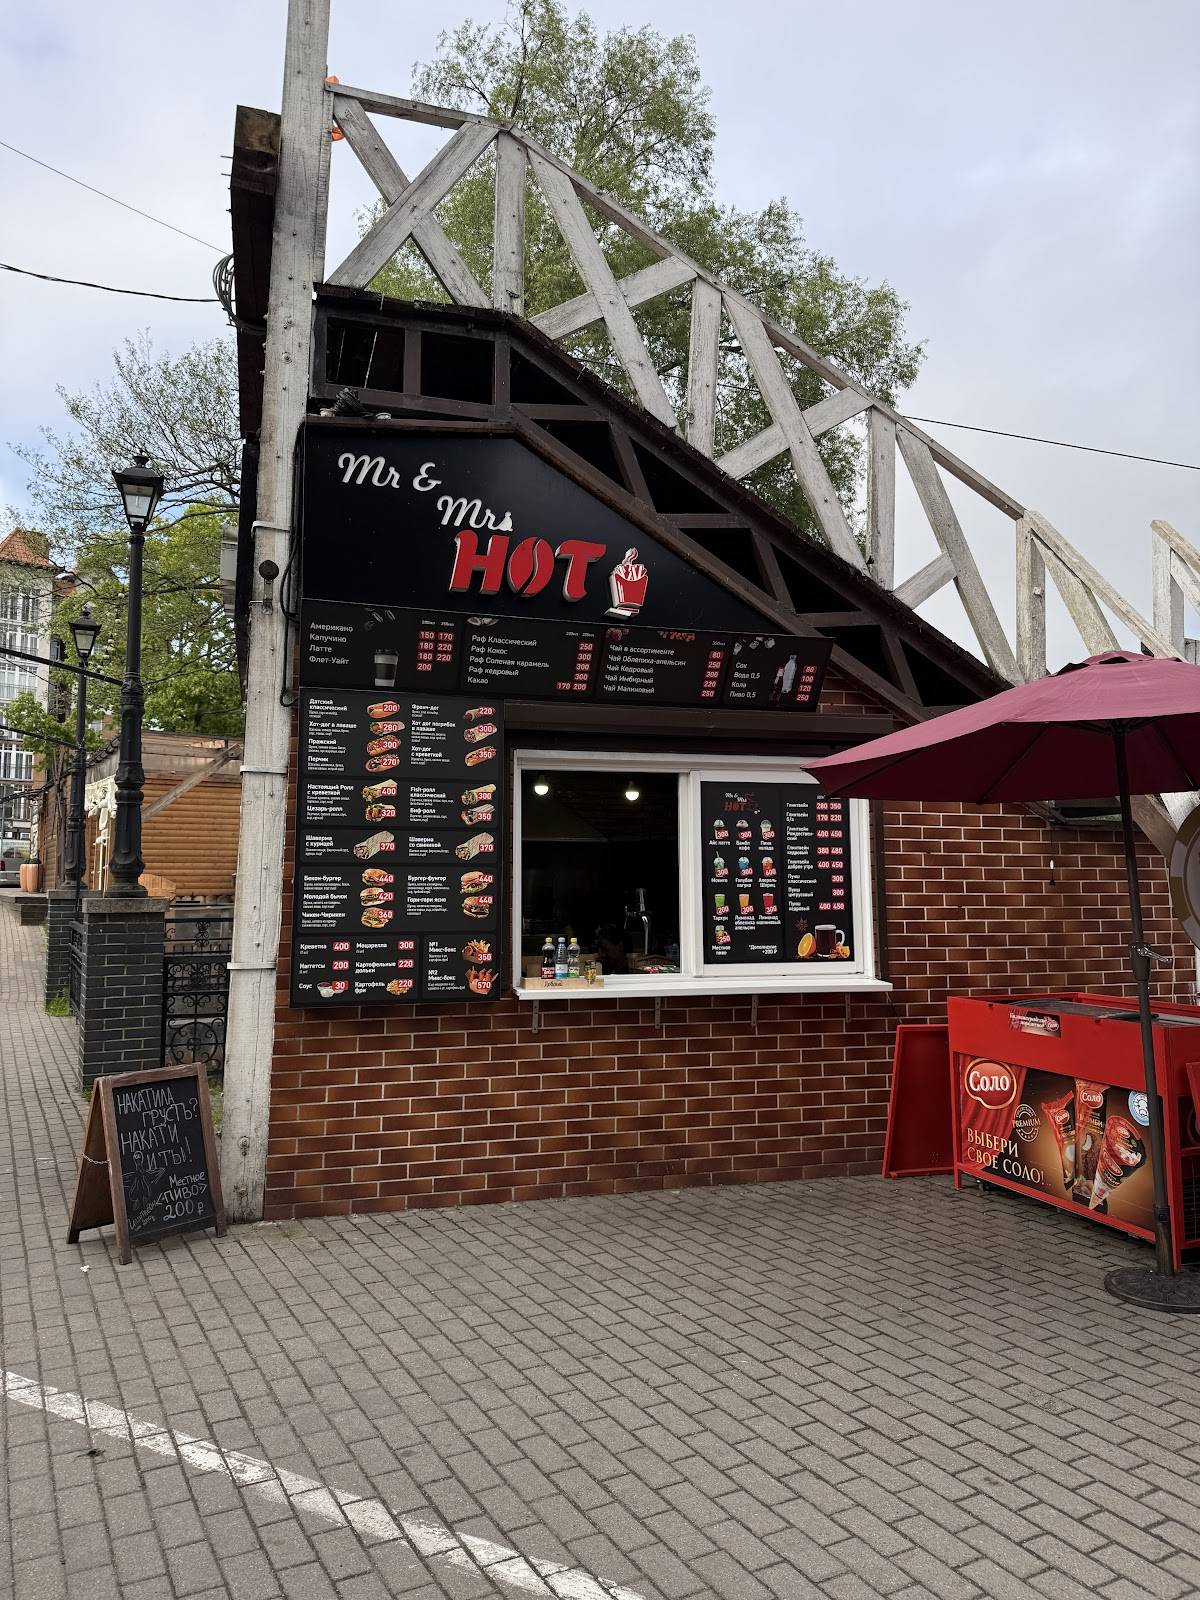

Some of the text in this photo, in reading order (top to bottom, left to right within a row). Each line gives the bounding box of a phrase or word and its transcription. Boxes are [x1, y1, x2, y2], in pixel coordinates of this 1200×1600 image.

[337, 452, 442, 491] Mr &
[436, 495, 513, 532] Mrs
[450, 529, 606, 602] HOT
[310, 622, 354, 632] Американо
[309, 633, 347, 643] Капучино
[420, 631, 453, 640] 150 170
[471, 635, 537, 647] Раф Классический
[309, 644, 332, 653] Латте
[419, 642, 452, 651] 180 220
[471, 645, 508, 655] Раф Кокос
[579, 643, 593, 651] 250
[609, 644, 675, 656] Чай ассортименте
[308, 655, 349, 665] Флет-Уайт
[419, 652, 451, 662] 180 220
[608, 654, 687, 666] Чай Облепиха-апельсин
[469, 656, 550, 668] Раф Соленая карамель
[707, 661, 721, 669] 250
[417, 663, 432, 671] 200
[469, 666, 519, 677] Раф кедровый
[575, 663, 590, 671] 300
[606, 664, 654, 674] Чай Кедровый
[467, 676, 489, 684] Какао
[574, 673, 588, 681] 300
[605, 674, 654, 684] Чай Имбирный
[733, 671, 761, 680] Вода 0,5
[557, 682, 587, 691] 170 200
[603, 684, 655, 694] Чай Малиновый
[731, 681, 747, 689] Кола
[701, 690, 715, 698] 250
[729, 690, 757, 699] Пиво 0,5
[796, 694, 809, 702] 250
[383, 704, 398, 712] 200
[479, 707, 493, 715] 220
[309, 720, 331, 728] Хот-дог
[383, 723, 398, 731] 280
[479, 725, 493, 733] 300
[308, 738, 337, 746] Пражский
[308, 755, 329, 763] Перчик
[478, 751, 492, 759] 350
[382, 758, 397, 766] 270
[381, 787, 396, 795] 400
[478, 792, 492, 800] 300
[307, 805, 343, 813] Цезарь-ролл
[381, 809, 396, 817] 320
[380, 842, 395, 850] 370
[479, 844, 494, 852] 370
[379, 875, 394, 883] 440
[479, 875, 493, 883] 440
[378, 893, 394, 901] 420
[478, 896, 493, 904] 440
[378, 911, 393, 919] 360
[300, 943, 327, 951] Креветка
[333, 941, 350, 950] 400
[399, 941, 414, 950] 300
[478, 953, 492, 961] 350
[333, 961, 349, 970] 200
[398, 960, 414, 968] 220
[335, 981, 346, 990] 30
[398, 979, 413, 988] 220
[477, 981, 491, 989] 570
[969, 1071, 1010, 1092] Соло
[117, 1087, 175, 1115] НАКАТИЛА
[1081, 1092, 1101, 1103] Соло
[142, 1097, 198, 1128] ГРУСТЬ?
[121, 1123, 179, 1155] НАКАТИ
[967, 1127, 1019, 1158] ВЫБЕРИ
[147, 1135, 193, 1171] И ТЫ!
[967, 1146, 1045, 1186] СВОЕ СОЛО!
[168, 1171, 206, 1189] Местное
[163, 1200, 195, 1222] 200
